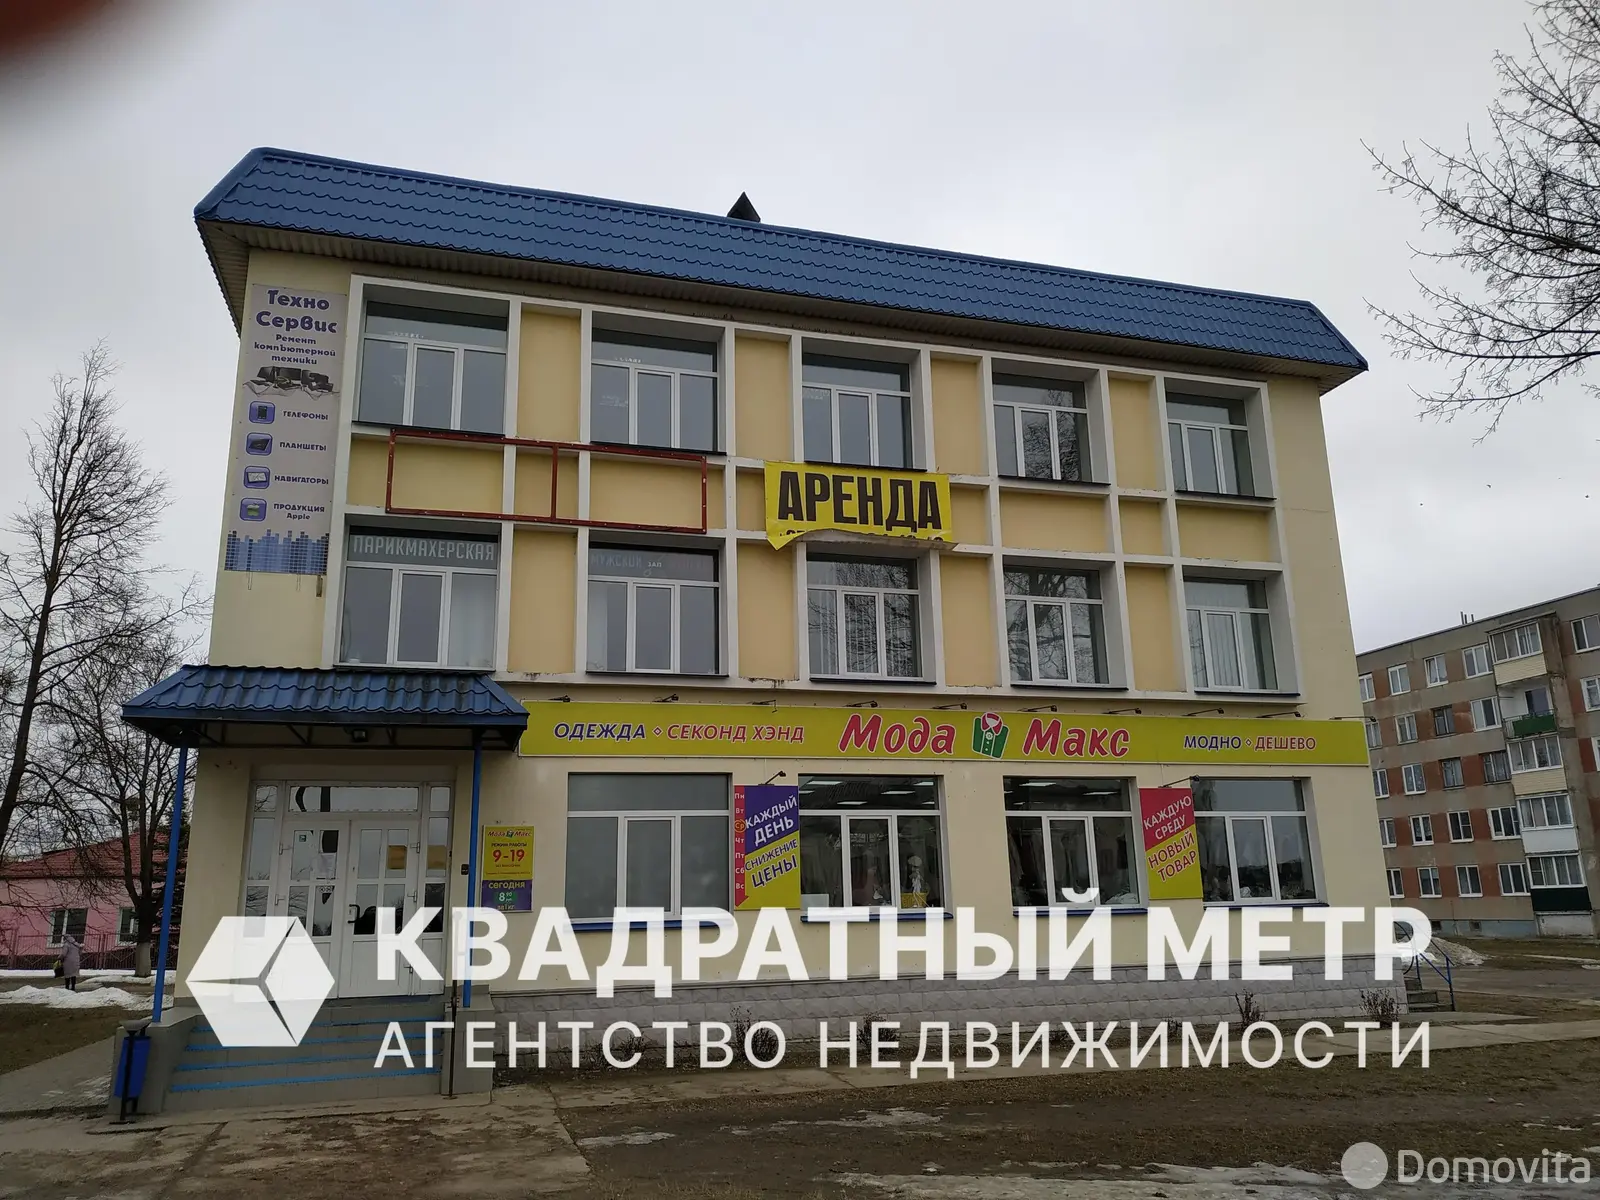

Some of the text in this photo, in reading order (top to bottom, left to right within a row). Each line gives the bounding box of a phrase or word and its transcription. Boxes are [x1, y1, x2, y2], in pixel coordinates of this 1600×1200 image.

[267, 289, 330, 310] Техно
[255, 310, 338, 333] Сервис
[271, 355, 318, 365] техники
[282, 410, 329, 421] ТЕЛЕФОНЫ
[279, 441, 327, 452] ПЛАНШЕТЫ
[274, 475, 329, 485] НАВИГАТОРЫ
[273, 503, 325, 514] ПРОДУКЦИЯ
[777, 470, 942, 533] АРЕНДА
[286, 512, 311, 521] Apple
[353, 535, 495, 561] ПАРИКМАХЕРСКАЯ
[553, 722, 804, 745] ОДЕЖДА СЕКОНД ХЭНД
[838, 713, 1130, 757] Мода Макс
[1184, 735, 1316, 752] МОДНО ДЕШЕВО
[745, 794, 798, 829] КАЖДЫЙ
[1144, 795, 1192, 830] КАЖДУЮ
[754, 815, 794, 846] ДЕНЬ
[1155, 814, 1186, 840] СРЕДУ
[745, 838, 798, 872] СНИЖЕНИЕ
[1148, 829, 1195, 869] НОВЫЙ
[751, 855, 798, 889] ЦЕНЫ
[1158, 850, 1197, 882] ТОВАР
